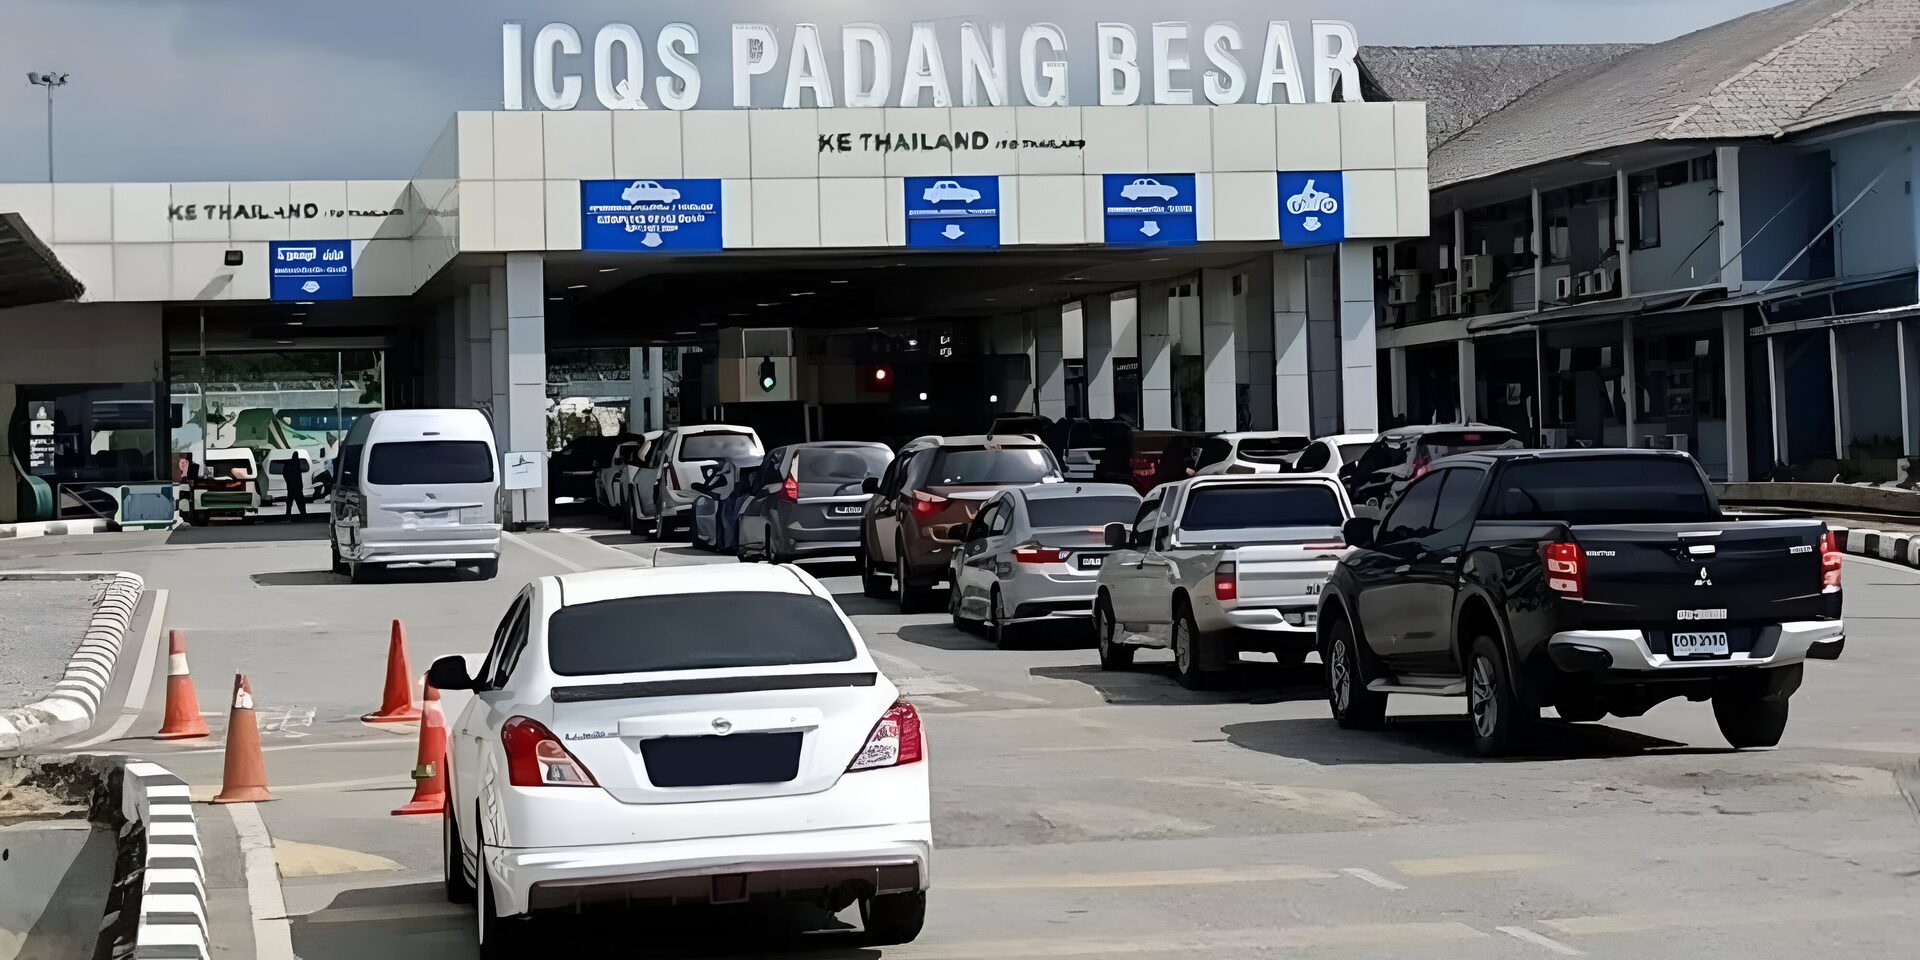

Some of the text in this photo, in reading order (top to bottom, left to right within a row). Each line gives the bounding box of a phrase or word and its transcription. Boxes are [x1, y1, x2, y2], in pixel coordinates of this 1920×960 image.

[502, 19, 1363, 111] ICQS PADANG BESAR
[818, 132, 852, 153] KE
[859, 131, 990, 153] THAILAND
[168, 204, 198, 221] KE
